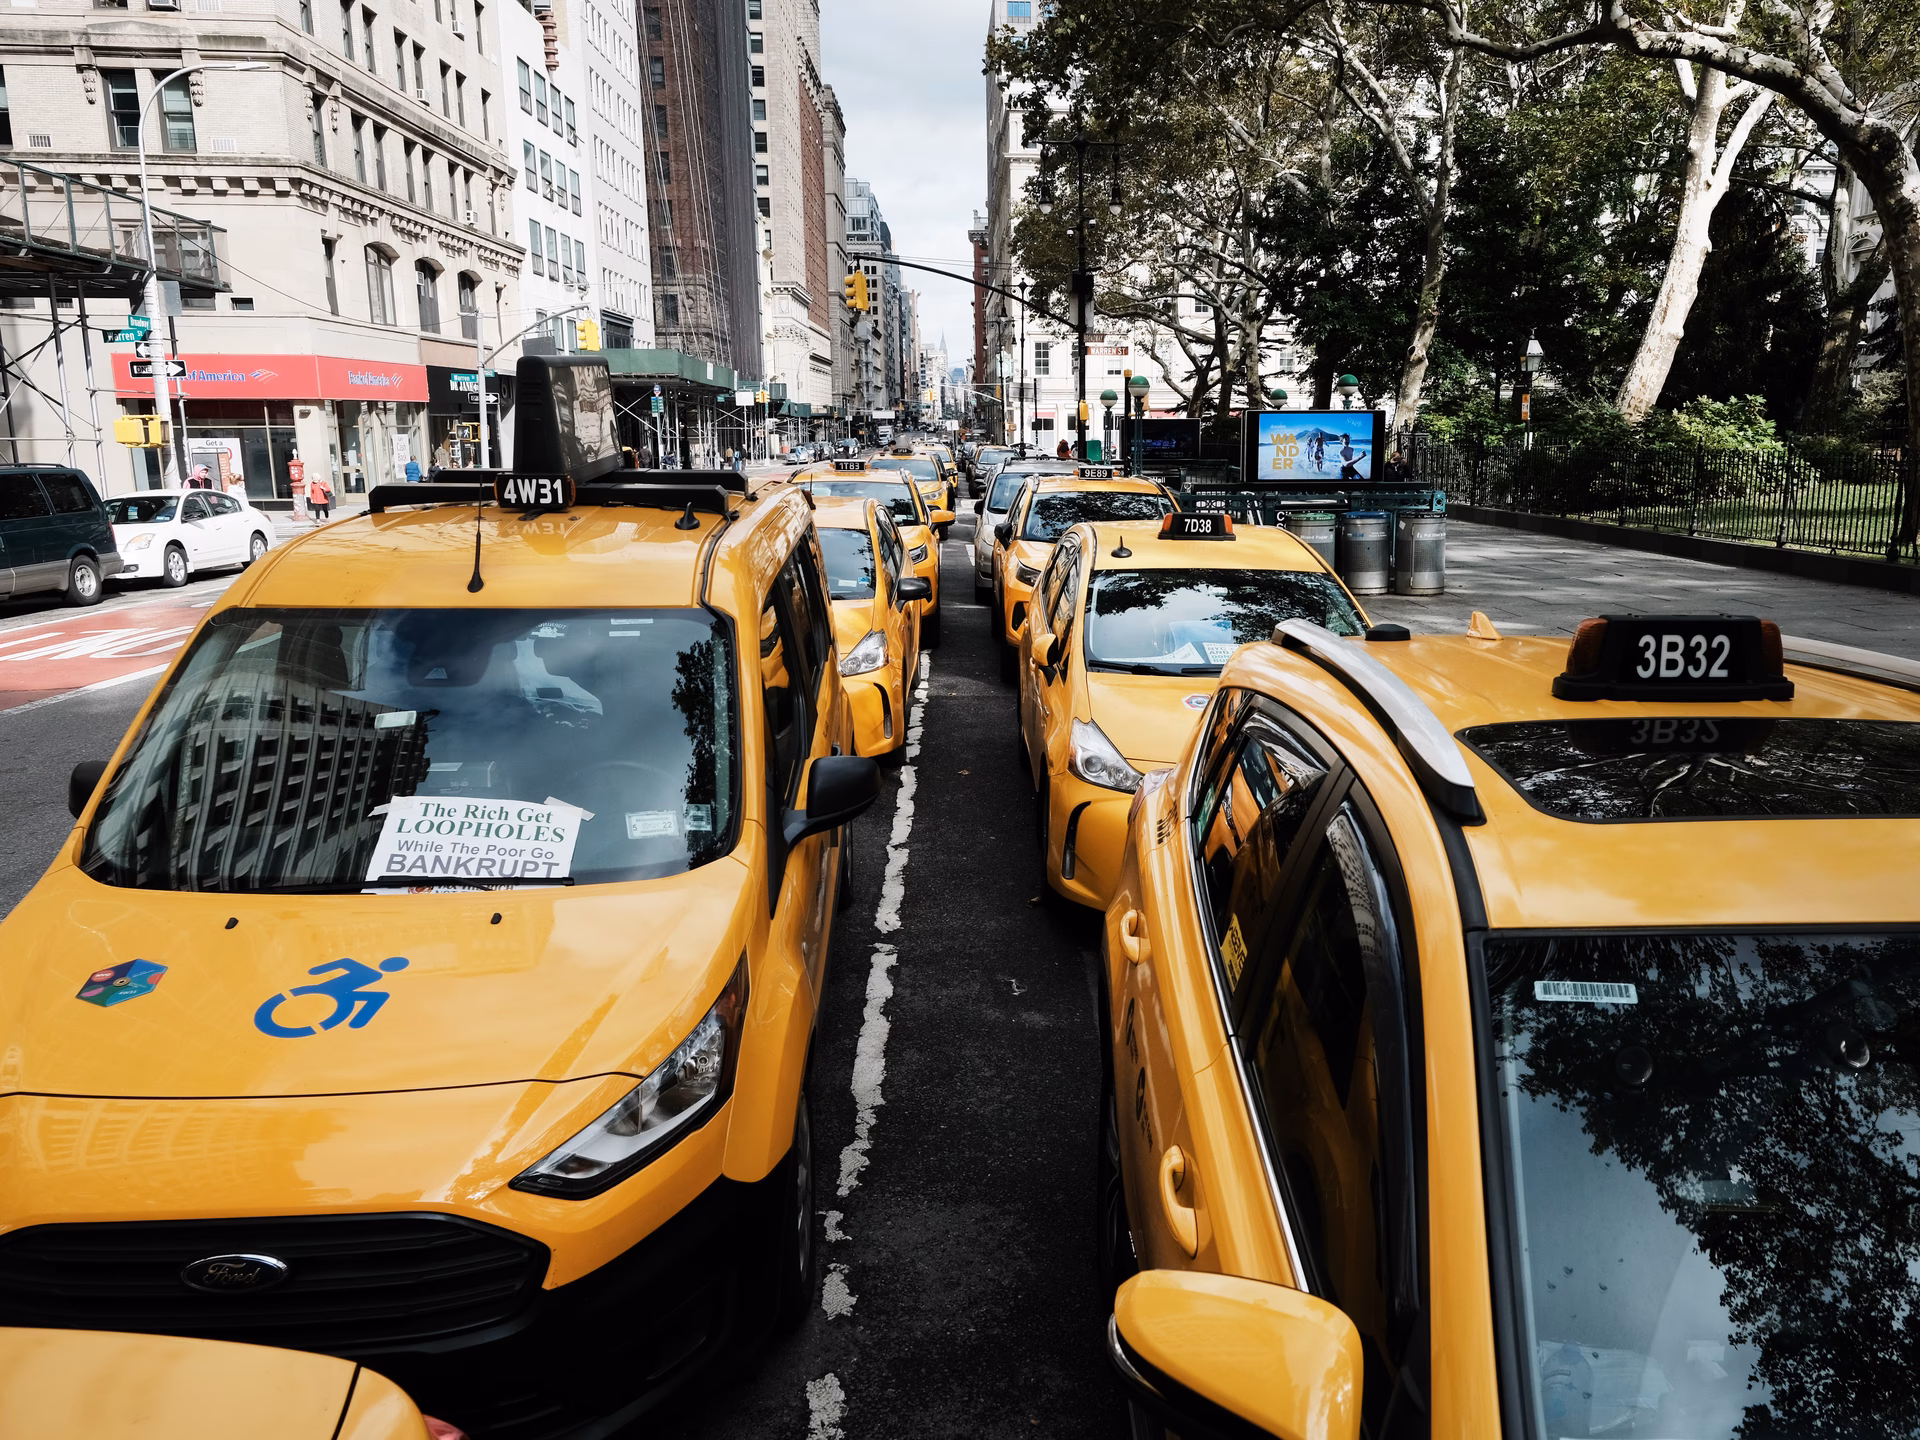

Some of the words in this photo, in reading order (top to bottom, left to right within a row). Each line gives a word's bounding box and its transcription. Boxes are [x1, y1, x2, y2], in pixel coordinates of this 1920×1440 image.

[130, 316, 150, 328] Broadway
[107, 331, 135, 341] Warren
[1090, 347, 1117, 355] WARREN
[1118, 347, 1125, 355] ST
[198, 370, 245, 381] America
[349, 371, 362, 384] Bank
[369, 373, 391, 386] America
[1270, 434, 1297, 445] WA
[1276, 445, 1299, 457] ND
[839, 462, 860, 470] 1T83
[1272, 458, 1294, 470] ER
[1085, 469, 1107, 478] 9E89
[504, 479, 563, 504] 4W31
[1184, 519, 1212, 533] 7D38
[1636, 634, 1731, 678] 3B32
[420, 802, 457, 818] The
[463, 804, 509, 821] Rich
[516, 807, 554, 824] Get
[395, 818, 566, 844] LOOPHOLES
[397, 840, 443, 853] While
[450, 842, 480, 855] The
[485, 844, 526, 858] Poor
[531, 847, 554, 860] Go
[385, 853, 560, 879] BANKRUPT
